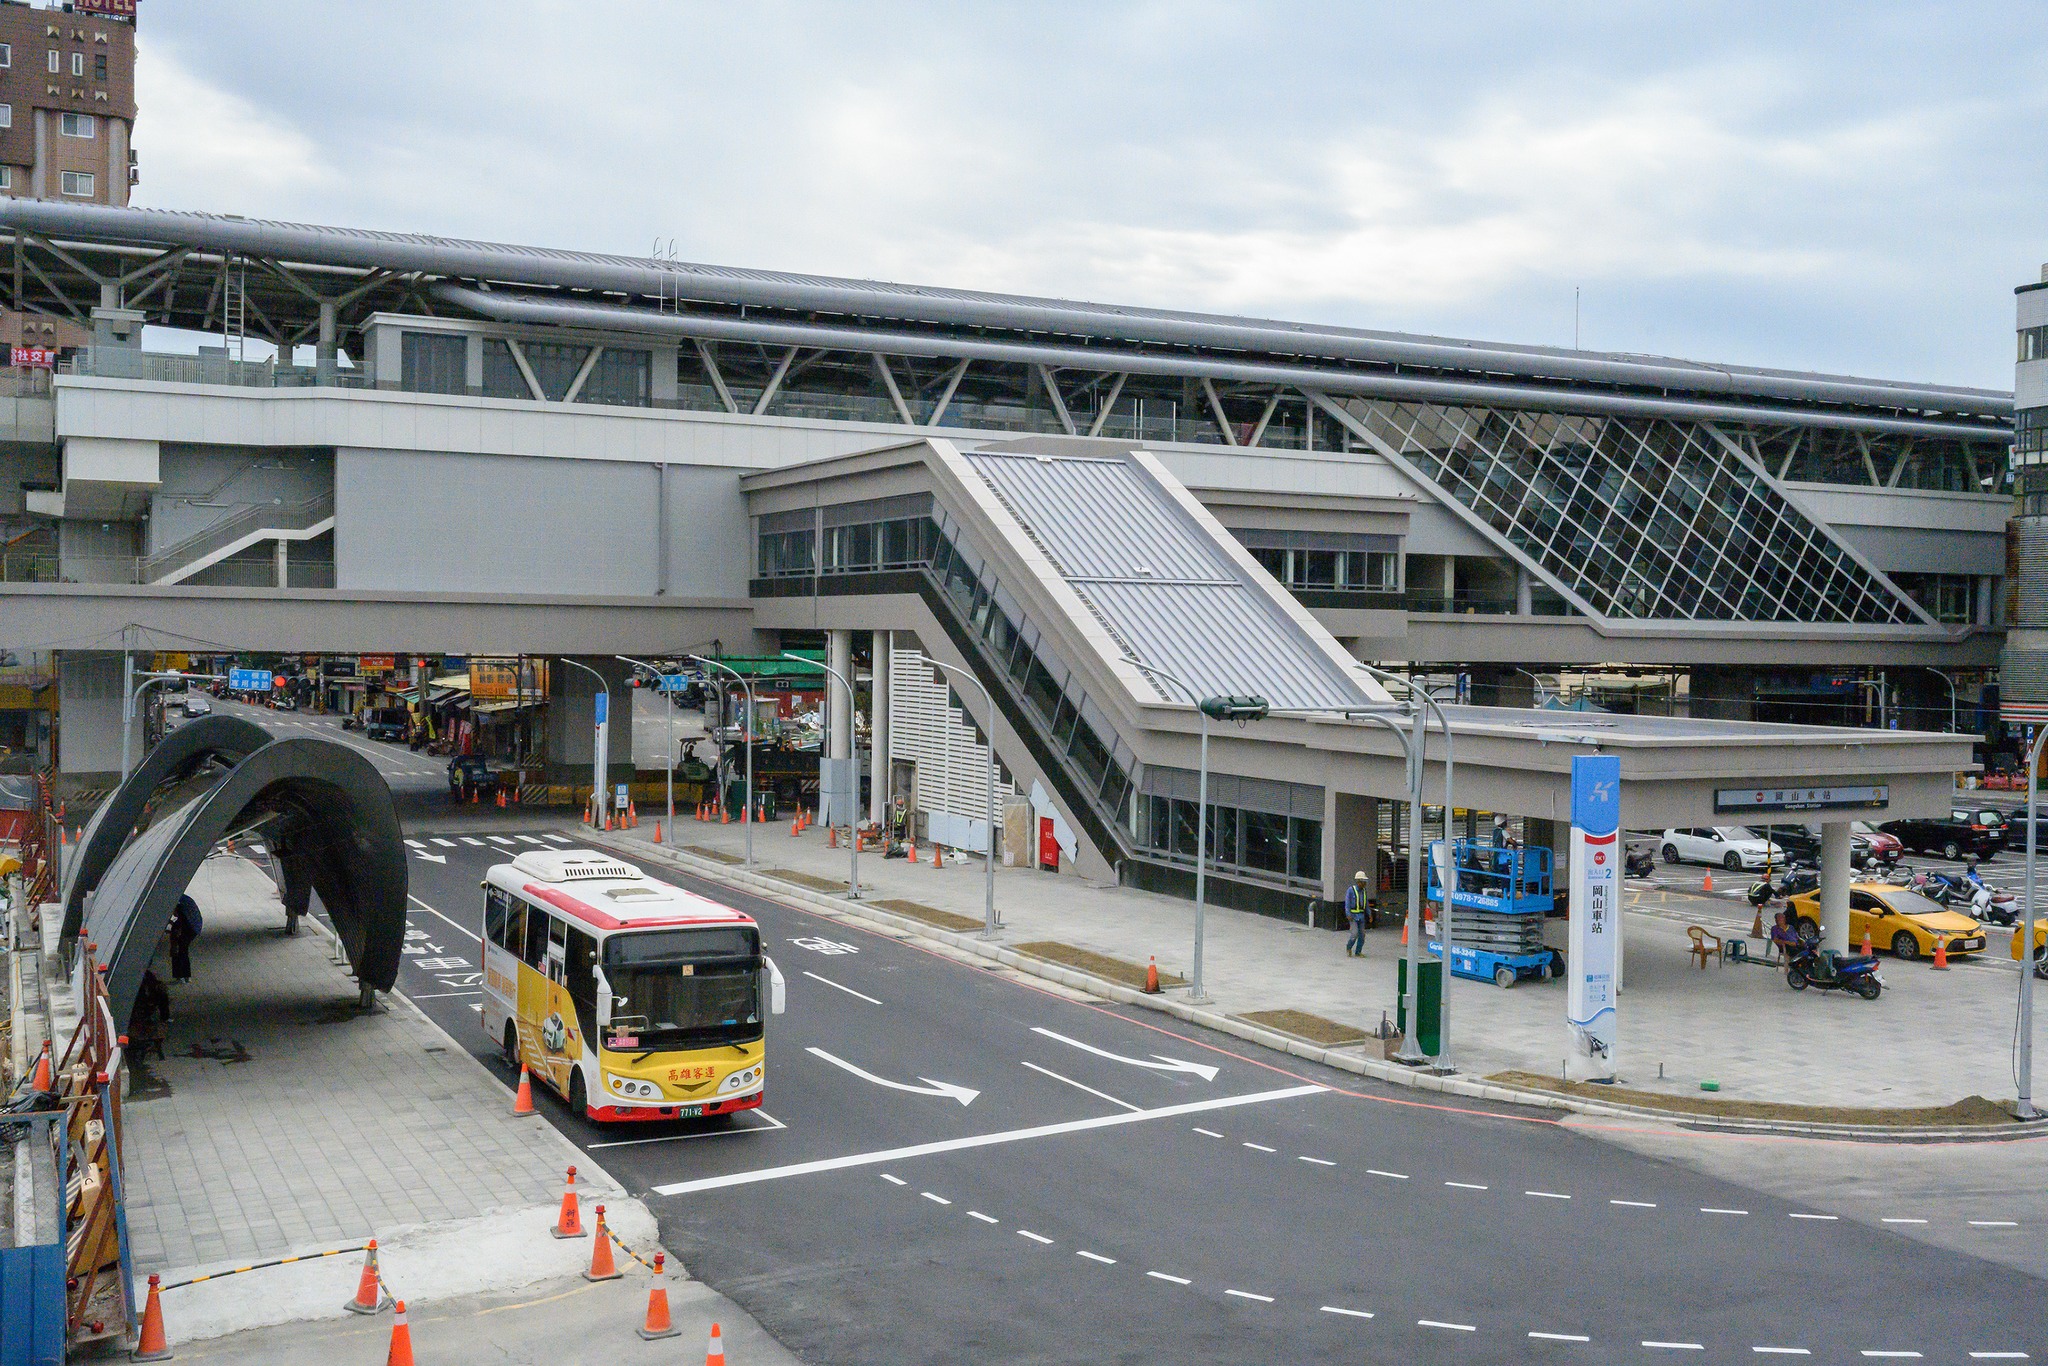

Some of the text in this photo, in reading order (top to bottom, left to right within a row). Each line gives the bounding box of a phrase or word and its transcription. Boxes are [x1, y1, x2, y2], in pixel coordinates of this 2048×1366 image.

[2027, 726, 2034, 737] P
[1775, 790, 1831, 802] 岡山車站
[1872, 789, 1882, 806] 2
[1605, 868, 1612, 879] 2
[1591, 885, 1603, 934] 岡山車站
[1601, 994, 1606, 1002] 2
[668, 1066, 715, 1082] 高雄客運
